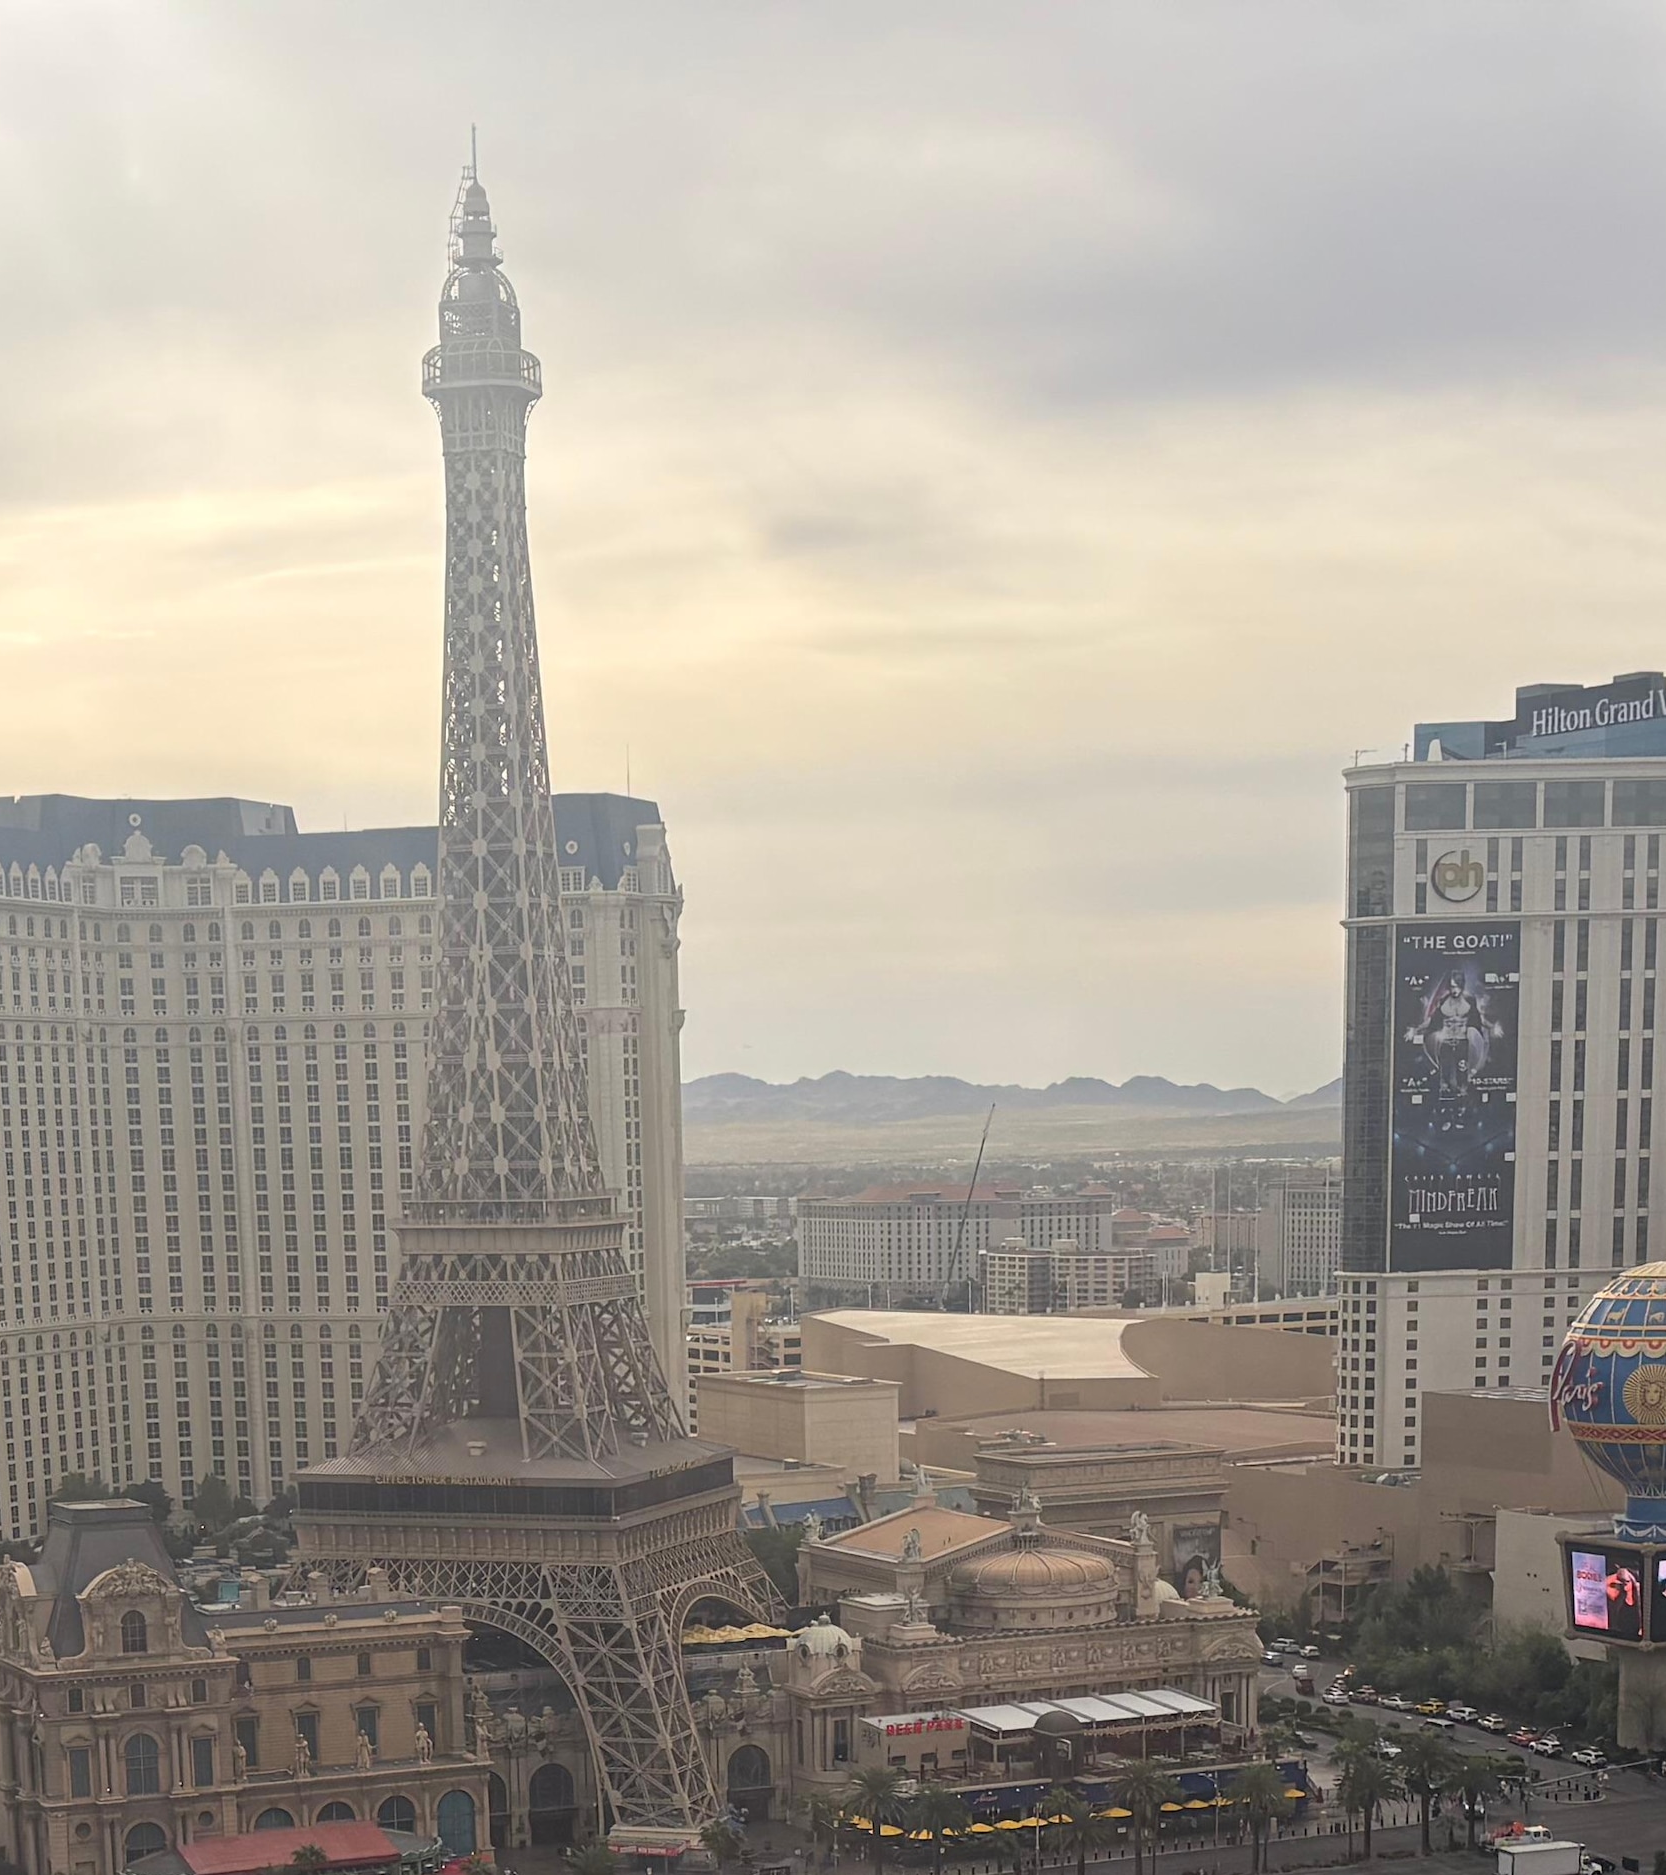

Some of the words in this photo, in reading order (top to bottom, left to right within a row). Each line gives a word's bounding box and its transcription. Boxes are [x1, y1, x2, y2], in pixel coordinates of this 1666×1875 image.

[1533, 707, 1591, 737] Hilton
[1595, 690, 1654, 727] Grand
[1437, 850, 1484, 896] ph
[1409, 1187, 1498, 1213] MINDFREAK
[1548, 1339, 1603, 1432] Paris
